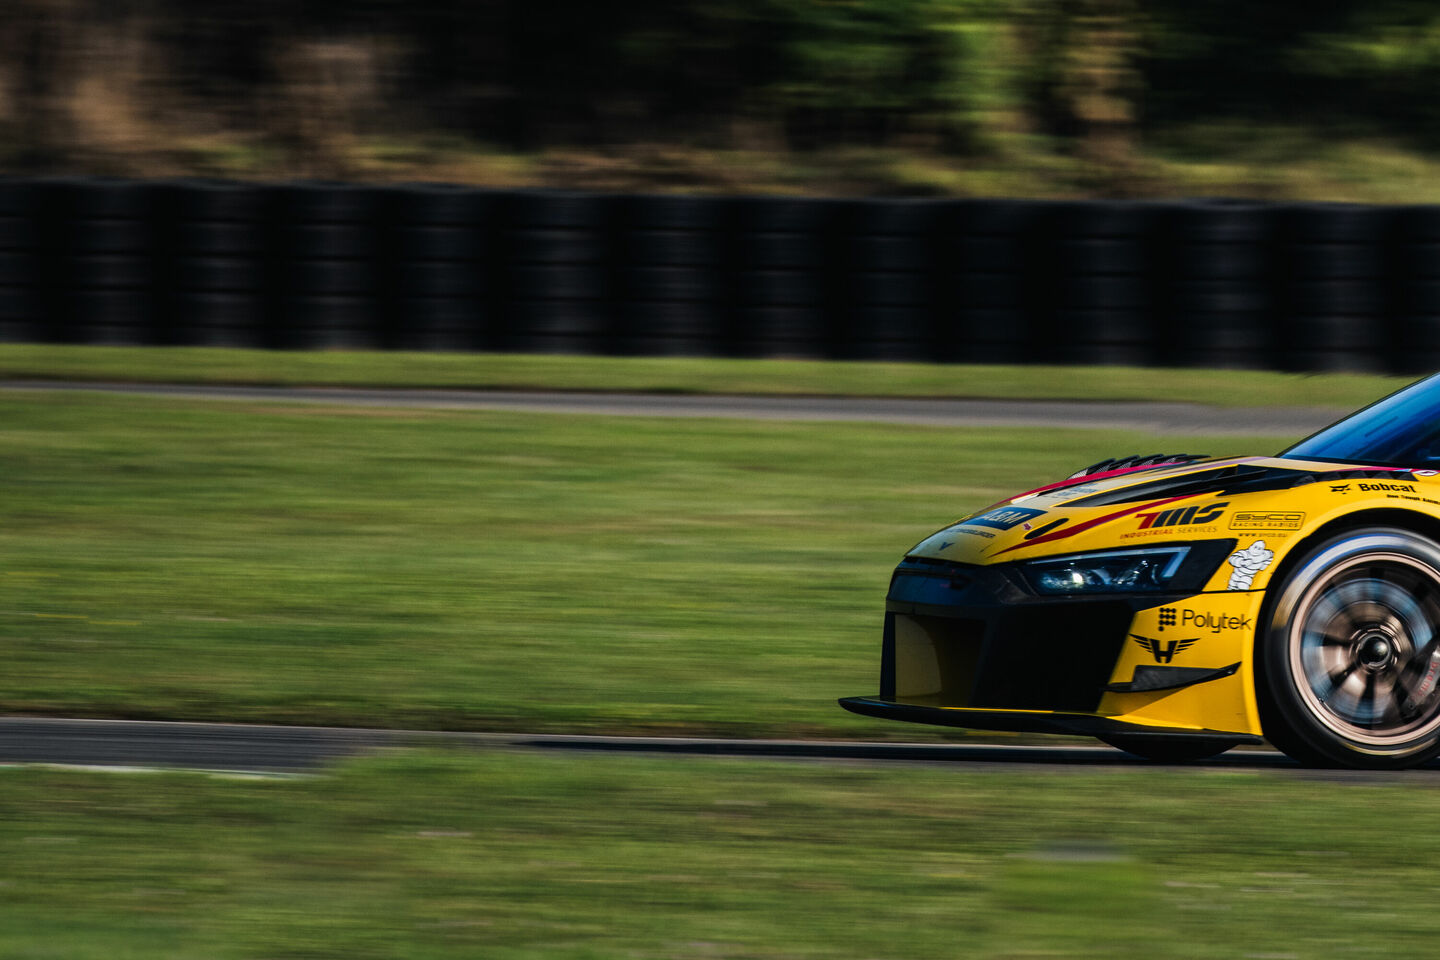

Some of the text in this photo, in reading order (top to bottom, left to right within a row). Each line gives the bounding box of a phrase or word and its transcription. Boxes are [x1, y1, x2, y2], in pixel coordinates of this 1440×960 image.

[1358, 483, 1417, 493] Bobcat
[1119, 525, 1219, 540] INDUSTRIAL SERVICES
[1182, 609, 1252, 633] Polytek
